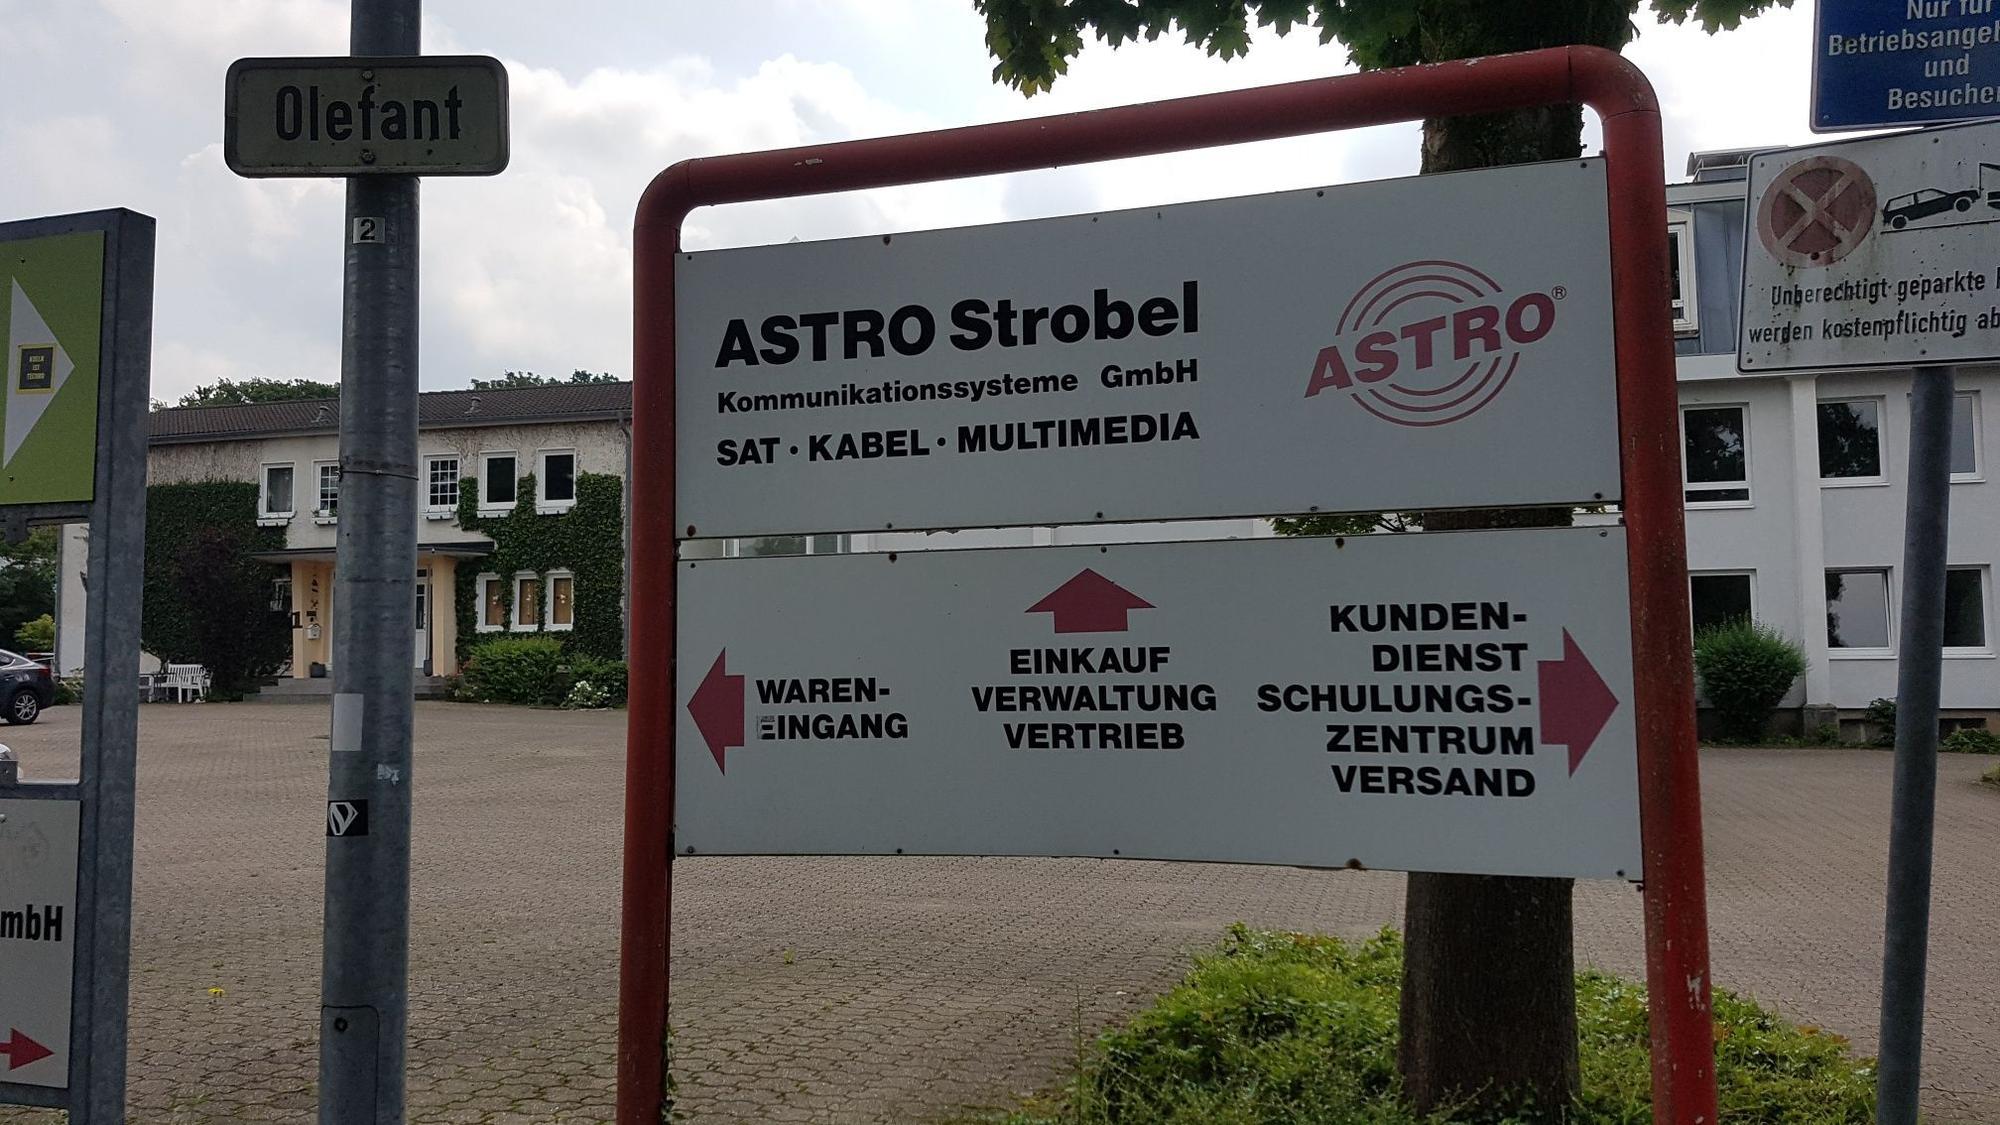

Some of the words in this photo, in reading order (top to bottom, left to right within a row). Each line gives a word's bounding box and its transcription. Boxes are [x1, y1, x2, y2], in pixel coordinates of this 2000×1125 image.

[1907, 0, 1951, 20] Nur
[1925, 54, 1970, 78] und
[275, 85, 463, 141] Olefant
[360, 219, 376, 240] 2
[1772, 279, 1888, 305] Unberechtigt
[1897, 270, 1985, 300] geparkte
[715, 305, 935, 368] ASTRO
[950, 280, 1198, 350] Strobel
[1749, 323, 1812, 344] werden
[1823, 309, 1967, 341] kostenpflichtig
[1304, 292, 1556, 398] ASTRO
[718, 372, 1078, 414] Kommunikationssysteme
[1101, 358, 1198, 388] GmbH
[716, 437, 780, 466] SAT
[809, 429, 930, 461] KABEL
[958, 411, 1200, 453] MULTIMEDIA
[1330, 602, 1527, 632] KUNDEN-
[1010, 647, 1170, 675] EINKAUF
[1372, 643, 1528, 672] DIENST
[756, 677, 890, 704] WAREN-
[972, 684, 1217, 712] VERWALTUNG
[1257, 684, 1531, 713] SCHULUNGS-
[1003, 722, 1184, 750] VERTRIEB
[1326, 724, 1535, 755] ZENTRUM
[1331, 764, 1536, 798] VERSAND
[0, 904, 63, 942] mbH
